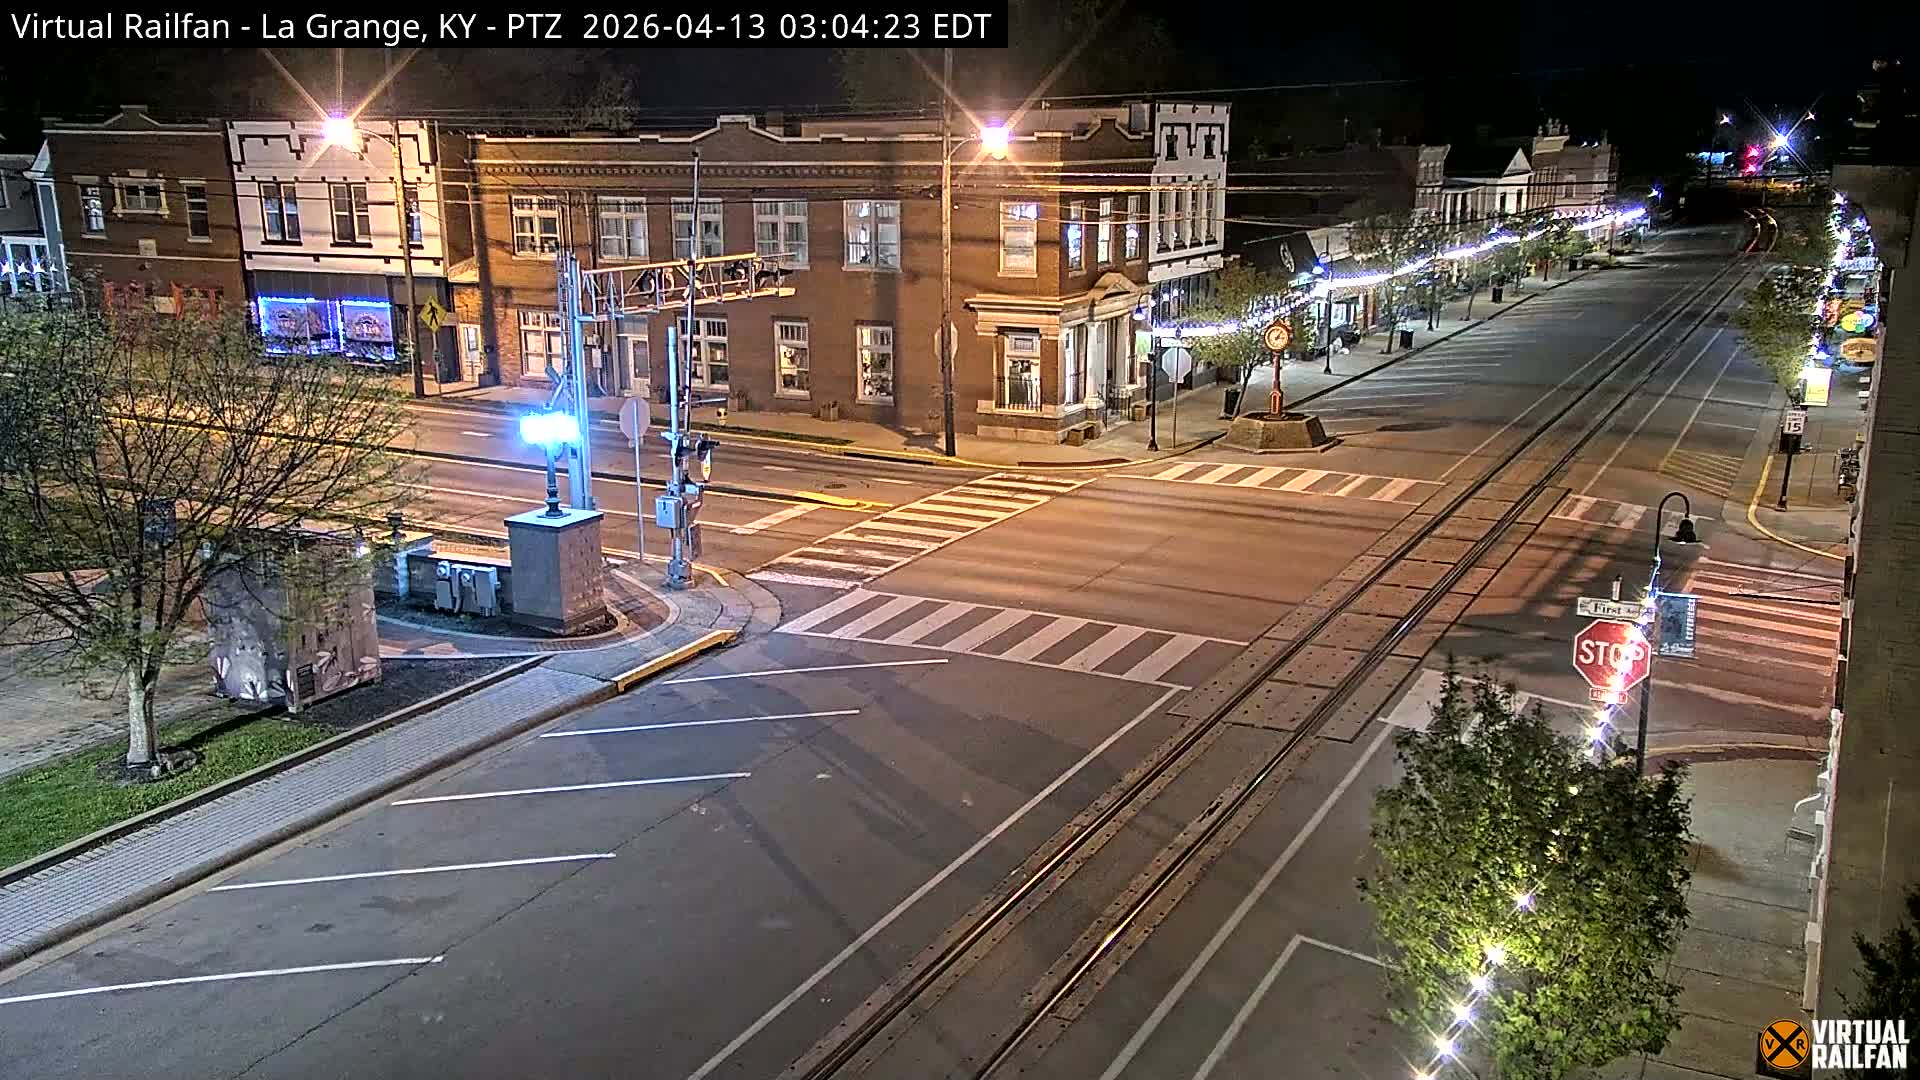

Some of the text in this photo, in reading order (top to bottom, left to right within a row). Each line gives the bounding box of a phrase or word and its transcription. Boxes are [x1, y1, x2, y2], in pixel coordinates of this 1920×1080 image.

[1788, 422, 1801, 432] 15
[1594, 602, 1621, 615] First
[1580, 639, 1645, 669] STOP
